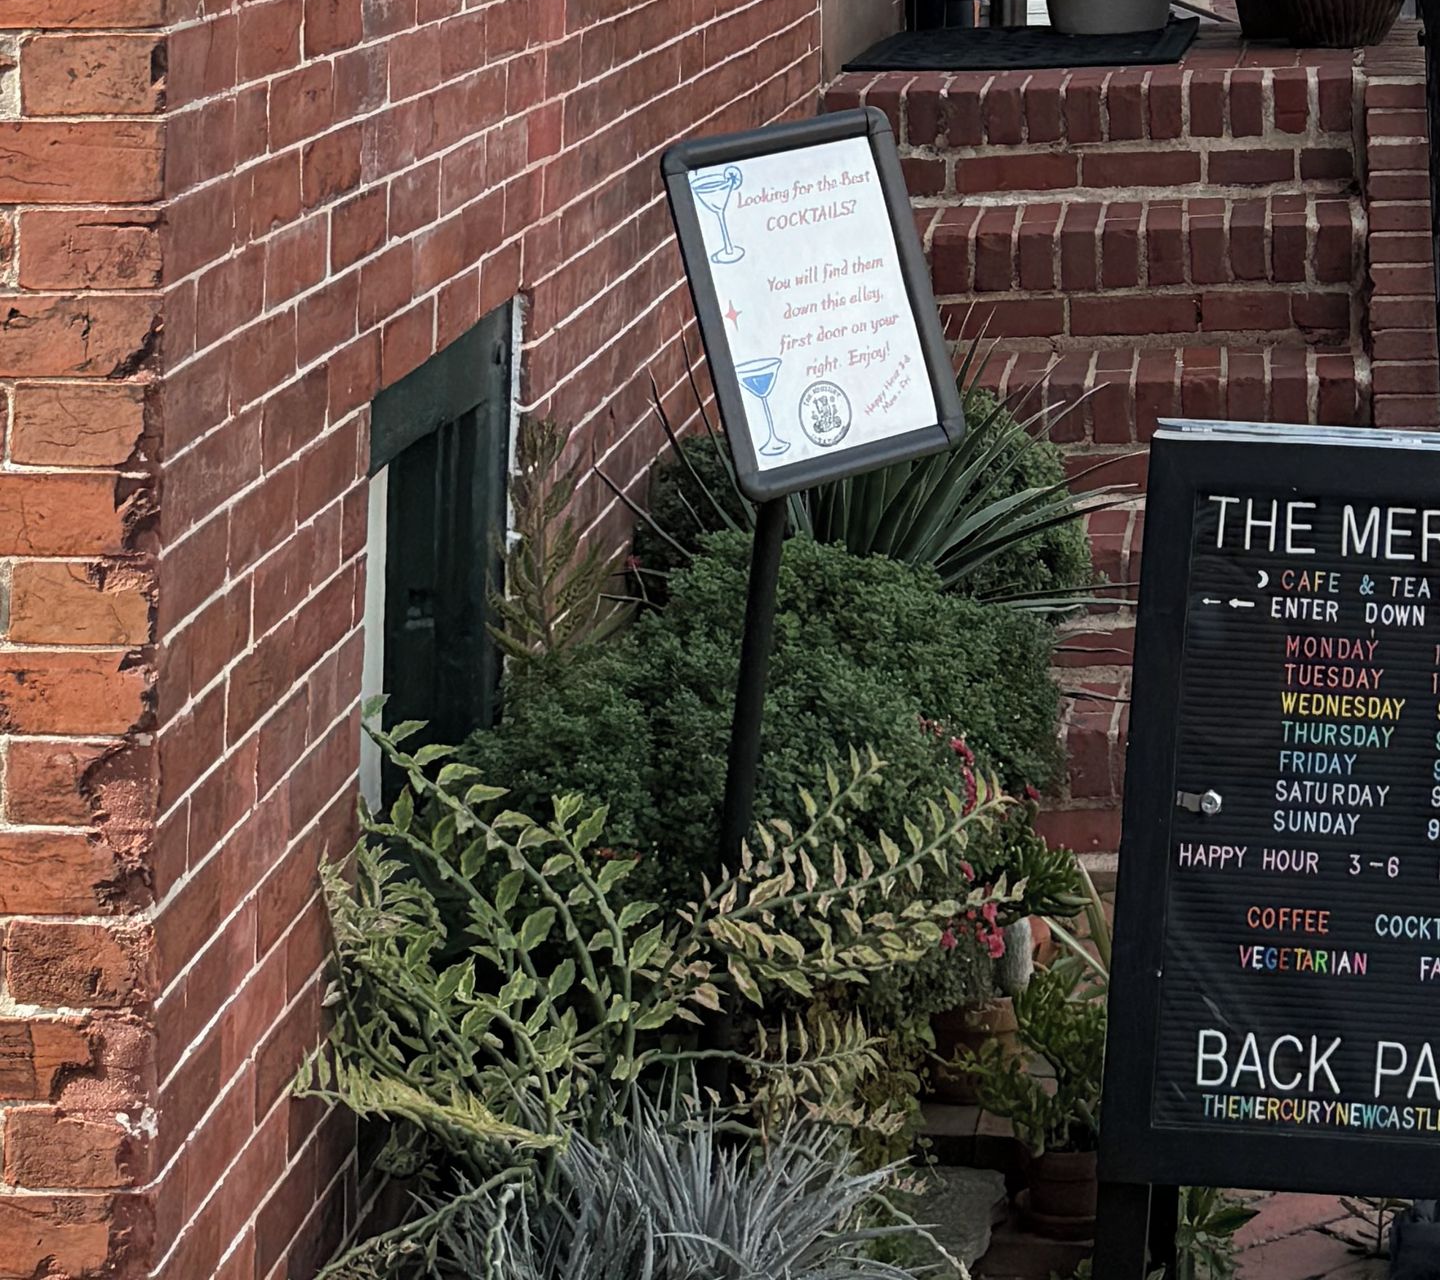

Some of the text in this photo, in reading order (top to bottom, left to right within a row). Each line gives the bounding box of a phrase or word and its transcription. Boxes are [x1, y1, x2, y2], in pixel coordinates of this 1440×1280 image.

[737, 170, 871, 209] Looking for the Best
[766, 199, 858, 232] COCKTAILS?
[767, 256, 884, 292] You will find them
[783, 302, 818, 320] down
[821, 291, 847, 311] this
[780, 313, 900, 355] first door on your
[848, 340, 890, 369] Enjoy!
[1208, 495, 1317, 556] THE
[1281, 570, 1341, 594] CAFE
[1359, 575, 1376, 596] &
[1390, 576, 1431, 600] TEA
[1270, 596, 1339, 624] ENTER
[1364, 602, 1426, 627] DOWN
[1286, 634, 1379, 662] MONDAY
[1284, 663, 1385, 691] TUESDAY
[1281, 691, 1406, 722] WEDNESDAY
[1281, 721, 1395, 749] THURSDAY
[1279, 751, 1357, 776] FRIDAY
[1275, 780, 1390, 807] SATURDAY
[1273, 810, 1361, 836] SUNDAY
[1179, 843, 1248, 870] HAPPY
[1263, 848, 1320, 873] HOUR
[1247, 906, 1331, 933] COFFEE
[1239, 945, 1368, 976] VEGETARIAN
[1196, 1028, 1341, 1095] BACK
